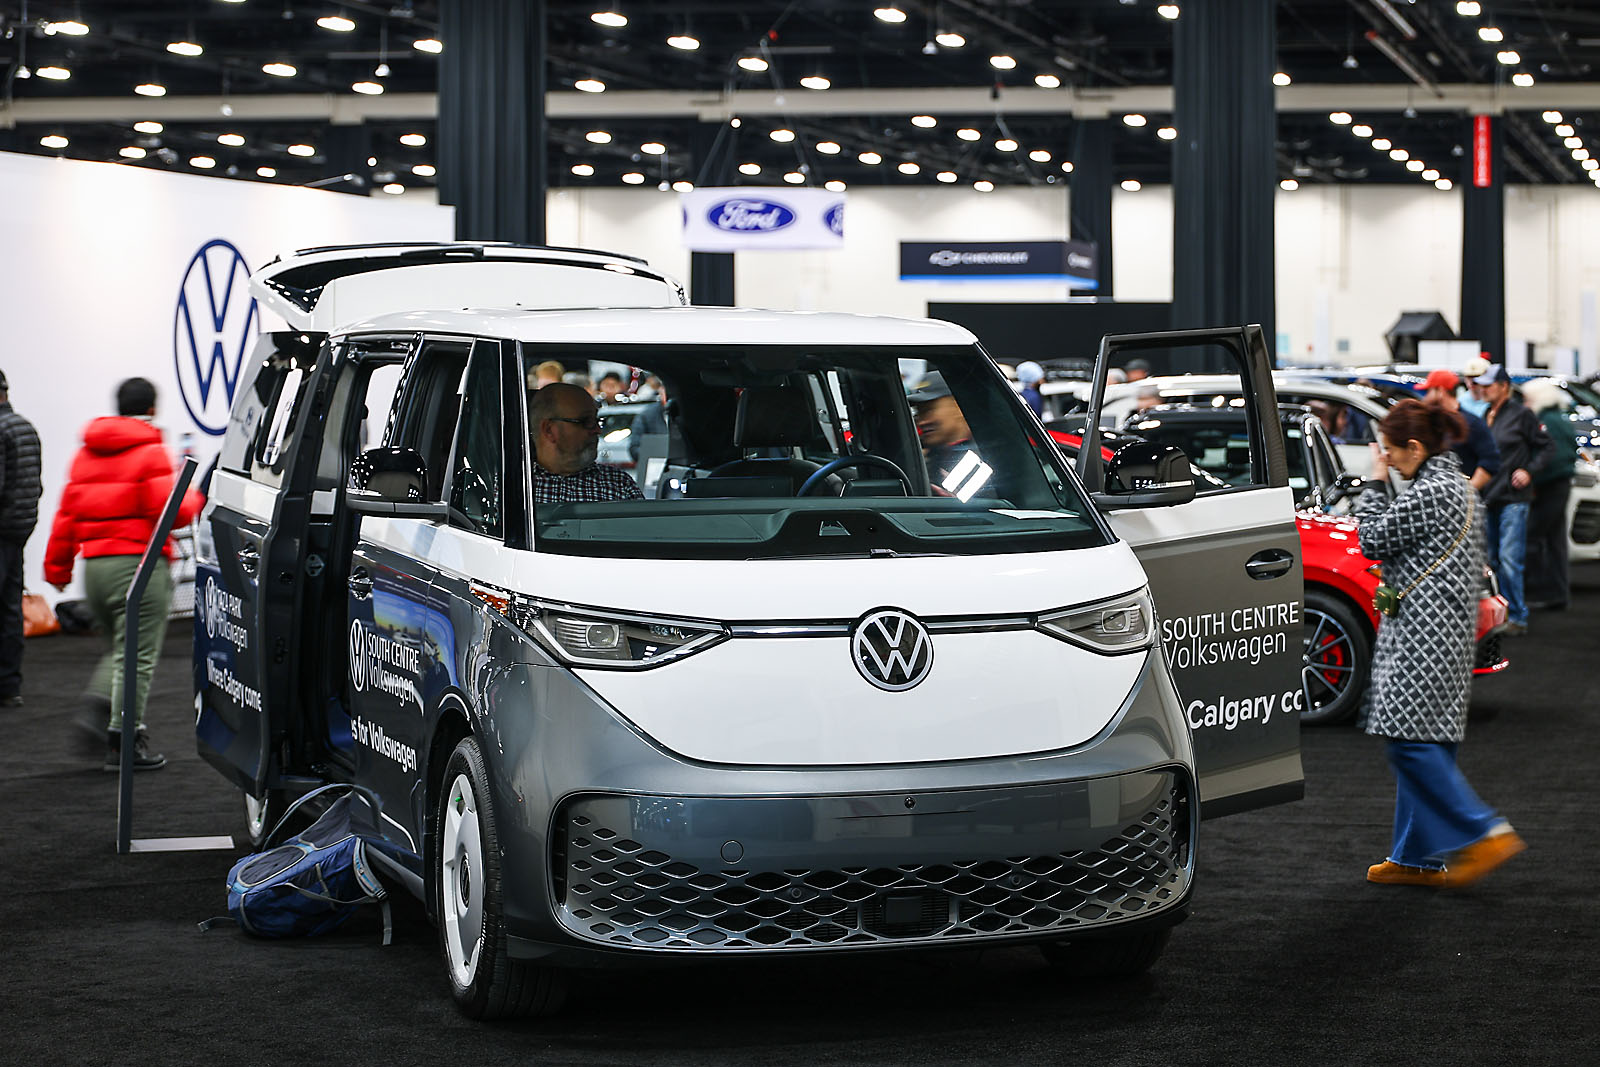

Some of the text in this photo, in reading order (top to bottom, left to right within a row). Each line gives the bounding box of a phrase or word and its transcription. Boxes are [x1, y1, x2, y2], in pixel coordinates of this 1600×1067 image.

[718, 200, 781, 229] Ford
[1163, 602, 1299, 642] SOUTH CENTRE
[368, 633, 420, 674] SOUTH CENTRE
[1164, 632, 1286, 669] Volkswagen
[224, 667, 244, 708] Calgary
[368, 656, 415, 707] Volkswagen
[1187, 694, 1276, 730] Calgary
[358, 715, 368, 746] for
[368, 720, 417, 773] Volkswagen
